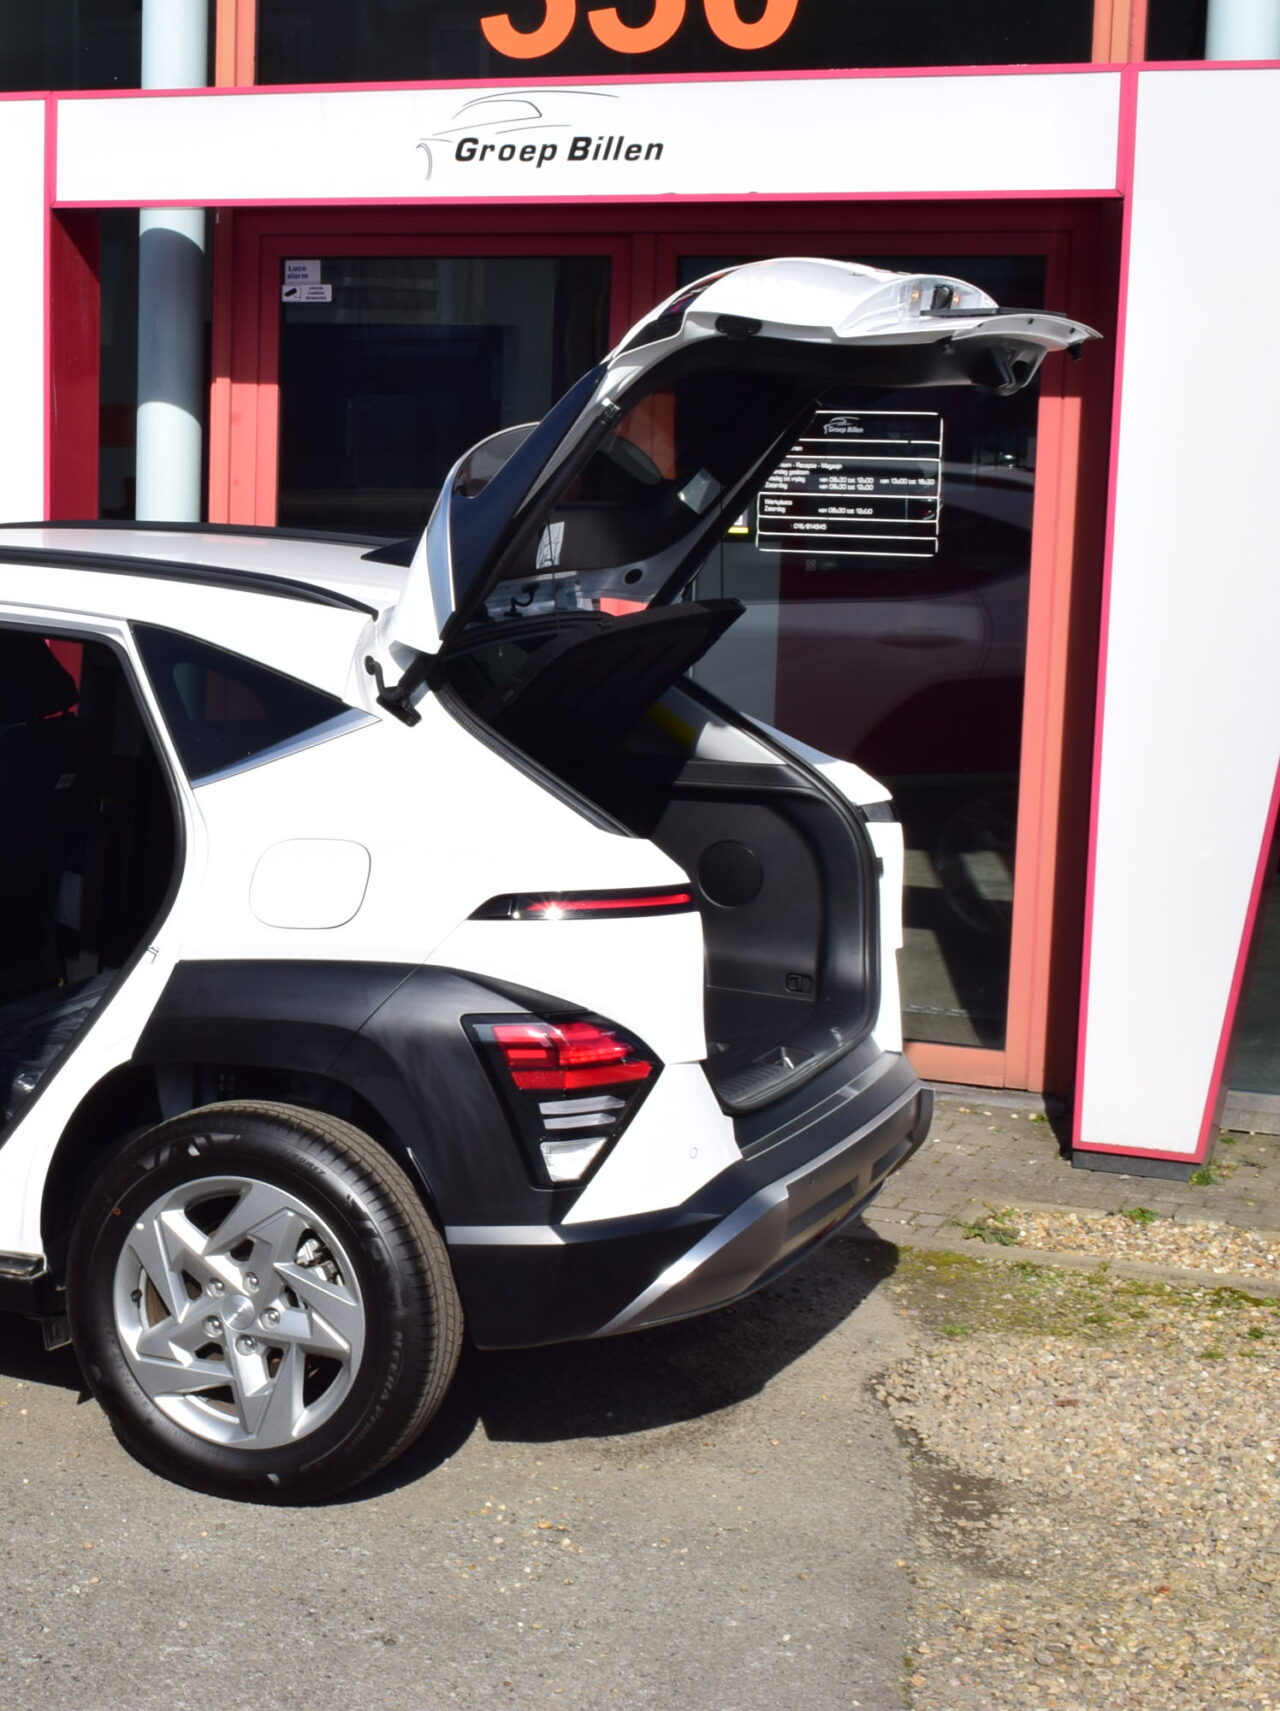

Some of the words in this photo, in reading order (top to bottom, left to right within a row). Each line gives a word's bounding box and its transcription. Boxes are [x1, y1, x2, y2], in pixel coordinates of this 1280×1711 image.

[454, 136, 558, 168] Groep
[567, 135, 664, 162] Billen
[828, 425, 846, 434] Groep
[847, 425, 864, 433] Billen
